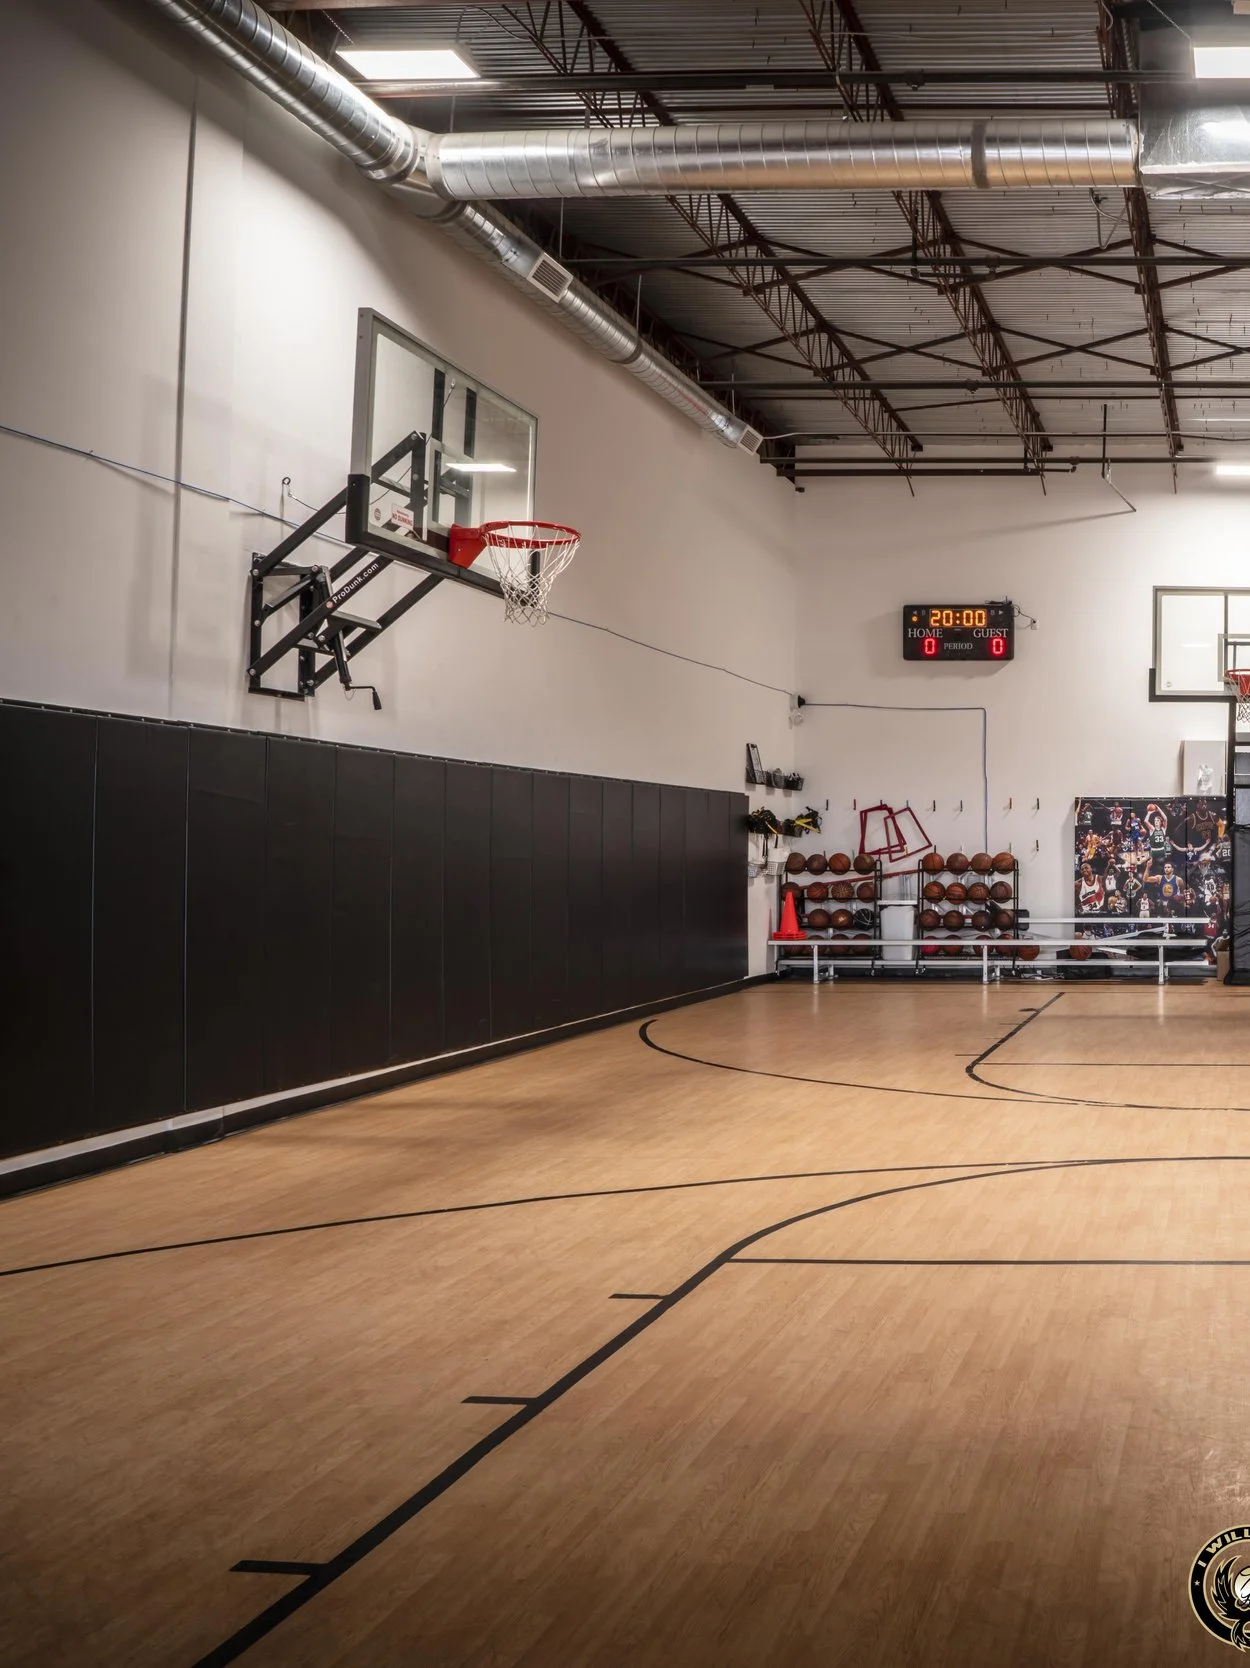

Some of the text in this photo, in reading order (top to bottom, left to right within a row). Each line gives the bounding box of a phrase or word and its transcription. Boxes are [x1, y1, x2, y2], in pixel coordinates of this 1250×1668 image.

[332, 563, 379, 603] ProDunk.com
[930, 610, 985, 626] 20:00
[908, 628, 1008, 638] HOME GUEST
[925, 638, 1003, 654] 0 PERIOD 0
